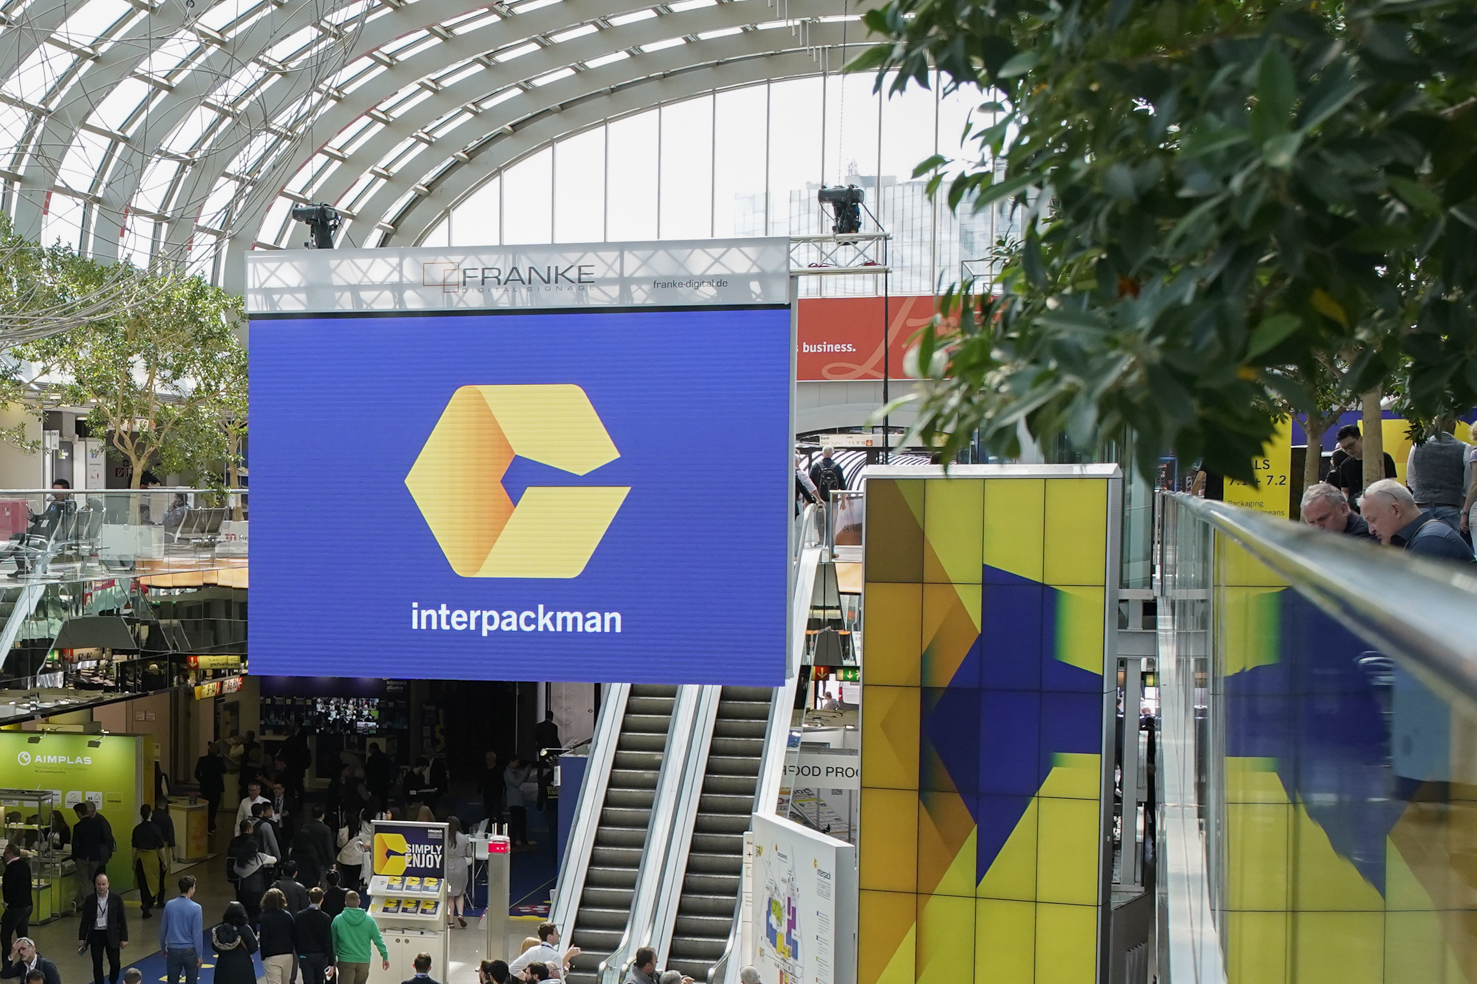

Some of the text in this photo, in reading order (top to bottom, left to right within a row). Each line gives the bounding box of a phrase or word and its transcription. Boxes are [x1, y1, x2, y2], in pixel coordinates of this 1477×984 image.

[462, 265, 595, 287] FRANKE
[653, 278, 728, 290] franke-digital.de
[803, 342, 856, 353] business.
[1266, 475, 1287, 486] 7.2
[412, 602, 622, 637] interpackman
[34, 755, 92, 765] AIMPLAS
[405, 844, 443, 855] SIMPLY
[405, 854, 443, 868] ENJOY
